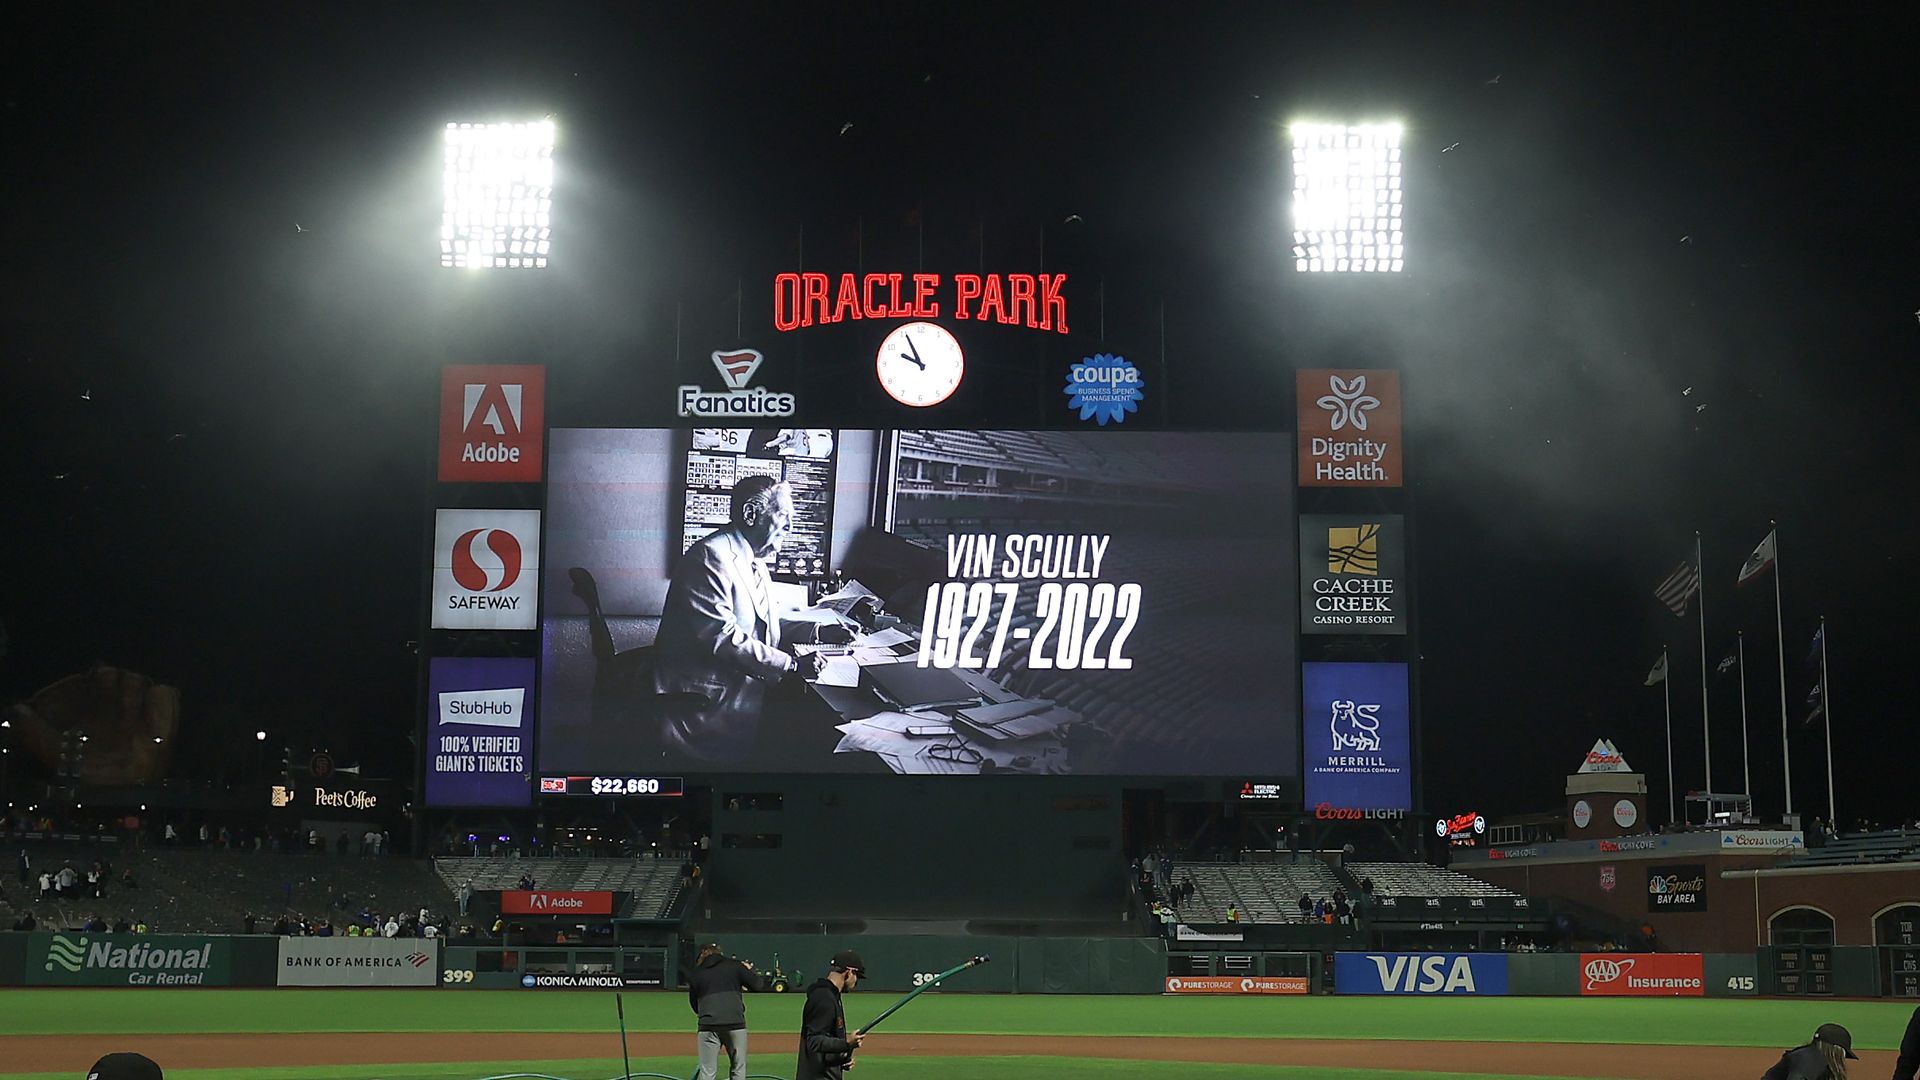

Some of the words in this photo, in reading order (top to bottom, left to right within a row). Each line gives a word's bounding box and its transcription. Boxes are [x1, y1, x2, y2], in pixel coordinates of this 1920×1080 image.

[774, 273, 940, 332] ORACLE
[954, 273, 1069, 335] PARK
[1073, 366, 1138, 388] coupa
[682, 389, 792, 413] Fanatics
[462, 442, 520, 462] Adobe
[1312, 437, 1387, 462] Dignity
[947, 534, 997, 578] VIN
[1001, 534, 1110, 579] SCULLY
[1313, 579, 1394, 594] CACHE
[449, 596, 520, 610] SAFEWAY
[1315, 596, 1392, 612] CREEK
[917, 582, 1142, 670] 1927-2022
[1313, 615, 1353, 624] CASINO
[1355, 615, 1395, 624] RESORT
[450, 700, 512, 715] StubHub
[440, 736, 470, 753] 100%
[472, 736, 520, 753] VERIFIED
[435, 755, 475, 772] GIANTS
[477, 755, 523, 772] TICKETS
[1328, 756, 1386, 766] MERRILL
[591, 777, 659, 795] $22,660
[314, 787, 343, 807] Peet's
[344, 790, 377, 810] Coffee
[1315, 801, 1363, 820] Coors
[1364, 808, 1405, 820] LIGHT
[1736, 834, 1764, 846] Coors
[1765, 838, 1789, 846] LIGHT
[1665, 875, 1704, 895] Sports
[551, 898, 583, 908] Adobe
[1657, 894, 1673, 904] BAY
[1673, 893, 1696, 903] AREA
[86, 942, 211, 969] National
[286, 957, 321, 966] BANK
[325, 957, 342, 966] OF
[345, 957, 402, 967] AMERICA
[443, 969, 474, 983] 399
[1366, 956, 1476, 992] VISA
[1590, 961, 1616, 978] AAA
[129, 972, 153, 985] Car
[156, 972, 203, 985] Rental
[537, 976, 577, 987] KONICA
[578, 976, 623, 987] MINOLTA
[1628, 975, 1700, 988] Insurance
[1727, 977, 1754, 990] 415
